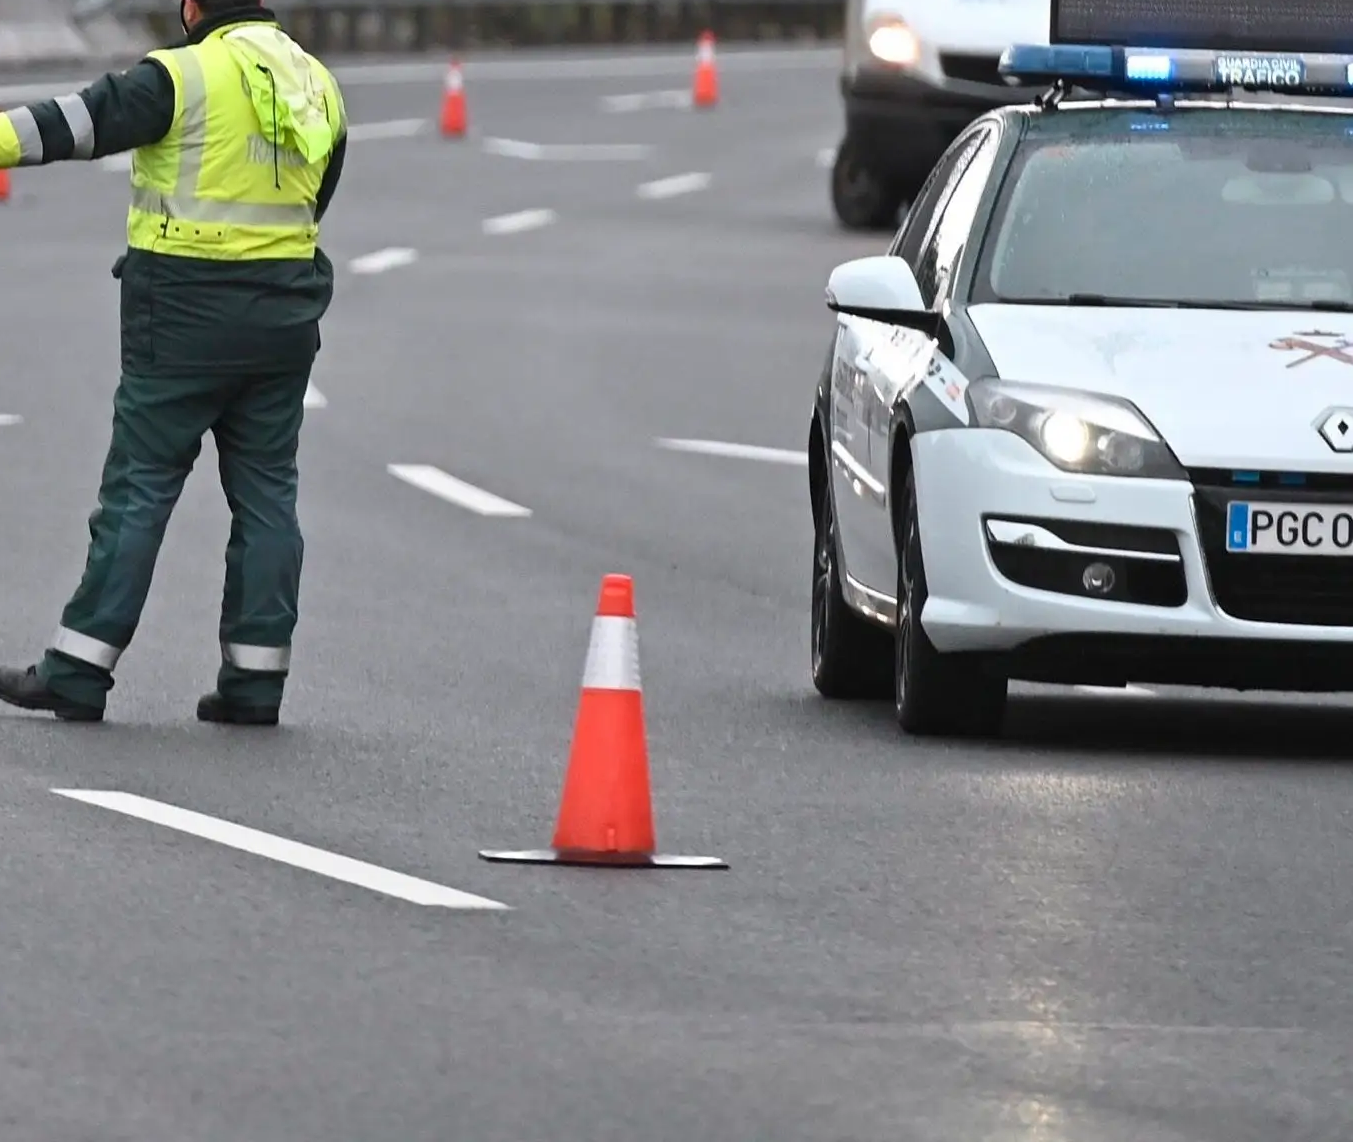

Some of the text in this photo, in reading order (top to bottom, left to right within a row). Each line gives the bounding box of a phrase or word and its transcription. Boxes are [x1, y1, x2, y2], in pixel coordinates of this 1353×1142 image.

[1217, 57, 1301, 72] GUARDIA CIVIL
[1251, 509, 1324, 548] PGC
